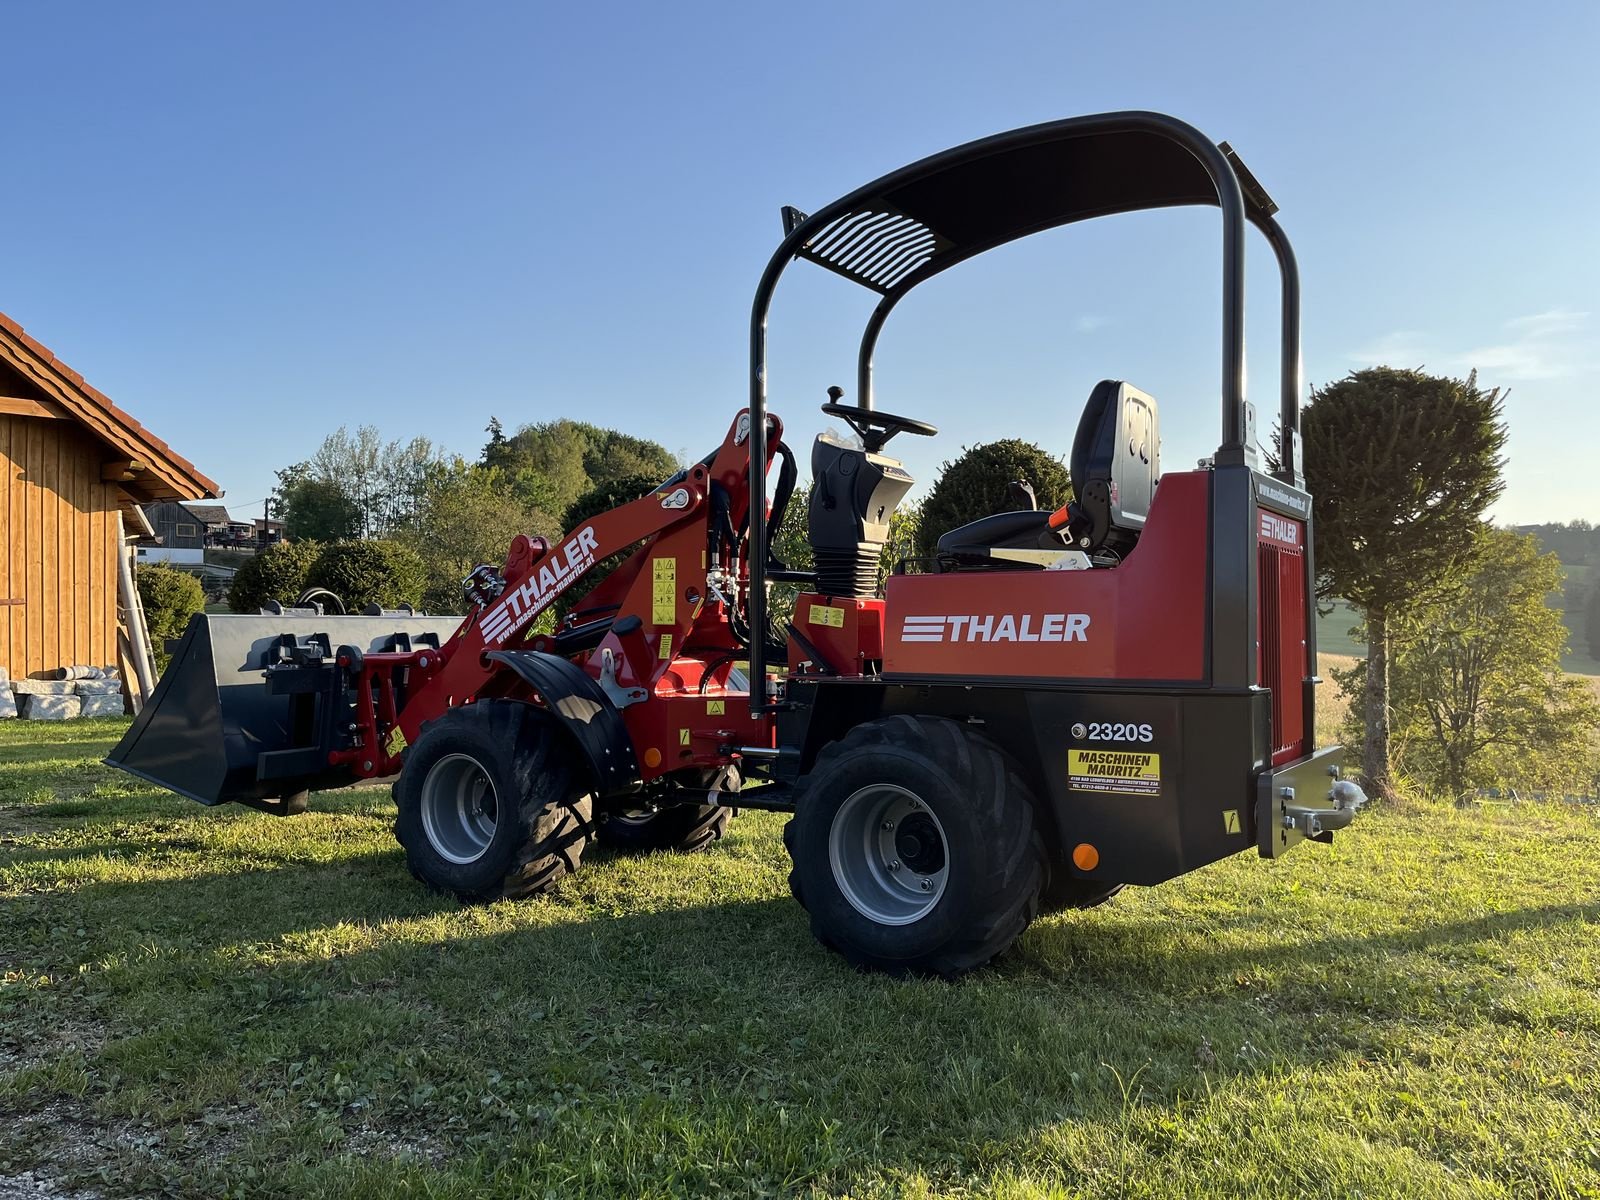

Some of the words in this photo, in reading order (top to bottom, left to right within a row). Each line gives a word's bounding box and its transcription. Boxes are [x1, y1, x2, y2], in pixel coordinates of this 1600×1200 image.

[1270, 517, 1297, 545] THALER
[506, 526, 599, 617] THALER
[496, 553, 595, 644] www.maschinen-mauritz.at
[946, 613, 1091, 642] THALER
[1088, 722, 1153, 742] 2320S
[1078, 752, 1151, 766] MASCHINEN
[1087, 764, 1142, 777] MAURITZ
